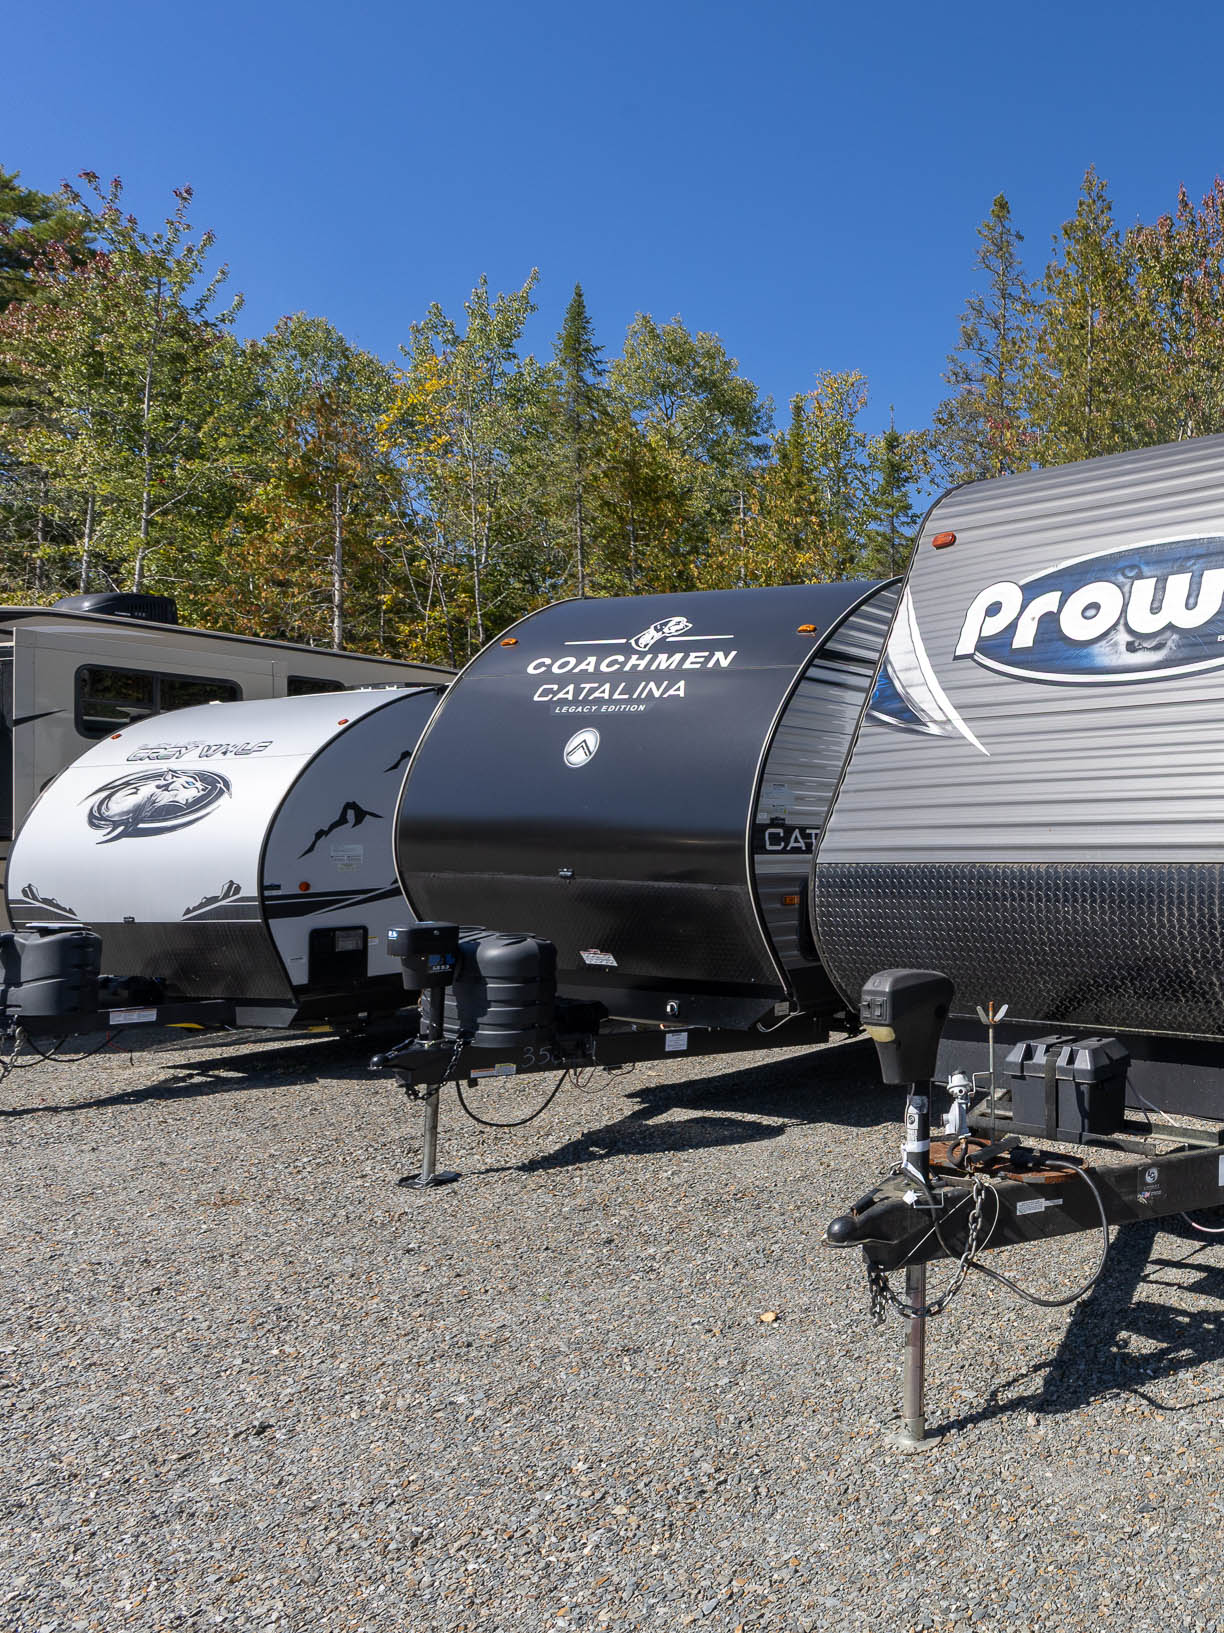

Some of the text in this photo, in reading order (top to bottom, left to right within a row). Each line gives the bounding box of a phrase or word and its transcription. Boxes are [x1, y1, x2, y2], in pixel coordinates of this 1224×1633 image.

[526, 650, 738, 675] COACHMEN
[533, 680, 686, 702] CATALINA
[555, 704, 646, 713] LEGACY EDITION
[126, 745, 199, 762] GREY
